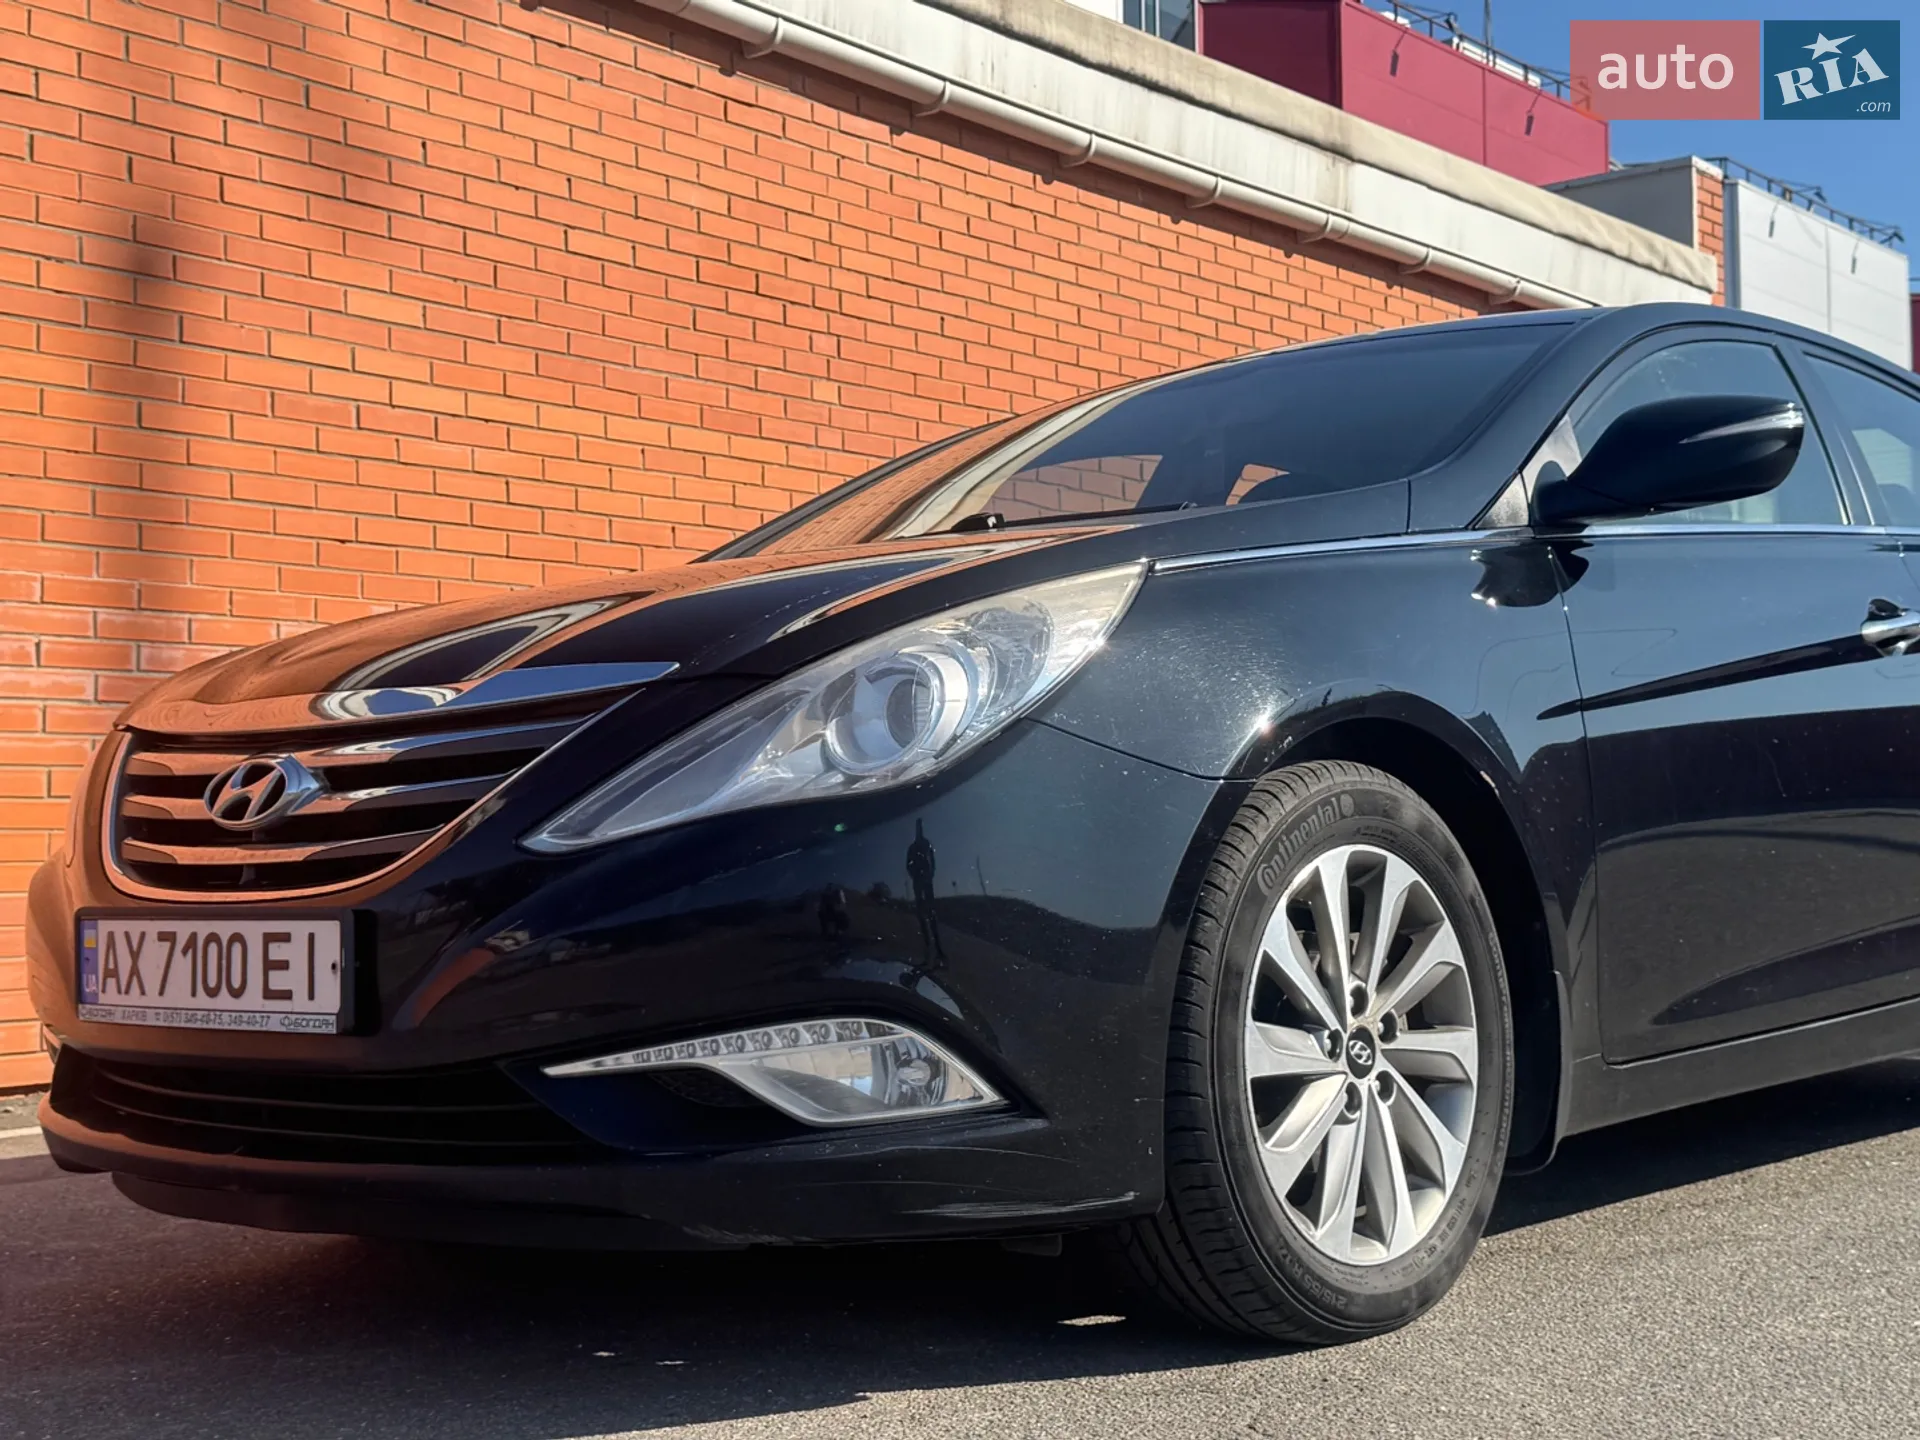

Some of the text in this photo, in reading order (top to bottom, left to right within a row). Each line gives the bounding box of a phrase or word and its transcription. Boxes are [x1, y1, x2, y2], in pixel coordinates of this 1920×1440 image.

[1257, 797, 1341, 896] Continental
[84, 974, 98, 992] UA
[101, 931, 315, 1001] AX 7100 EI
